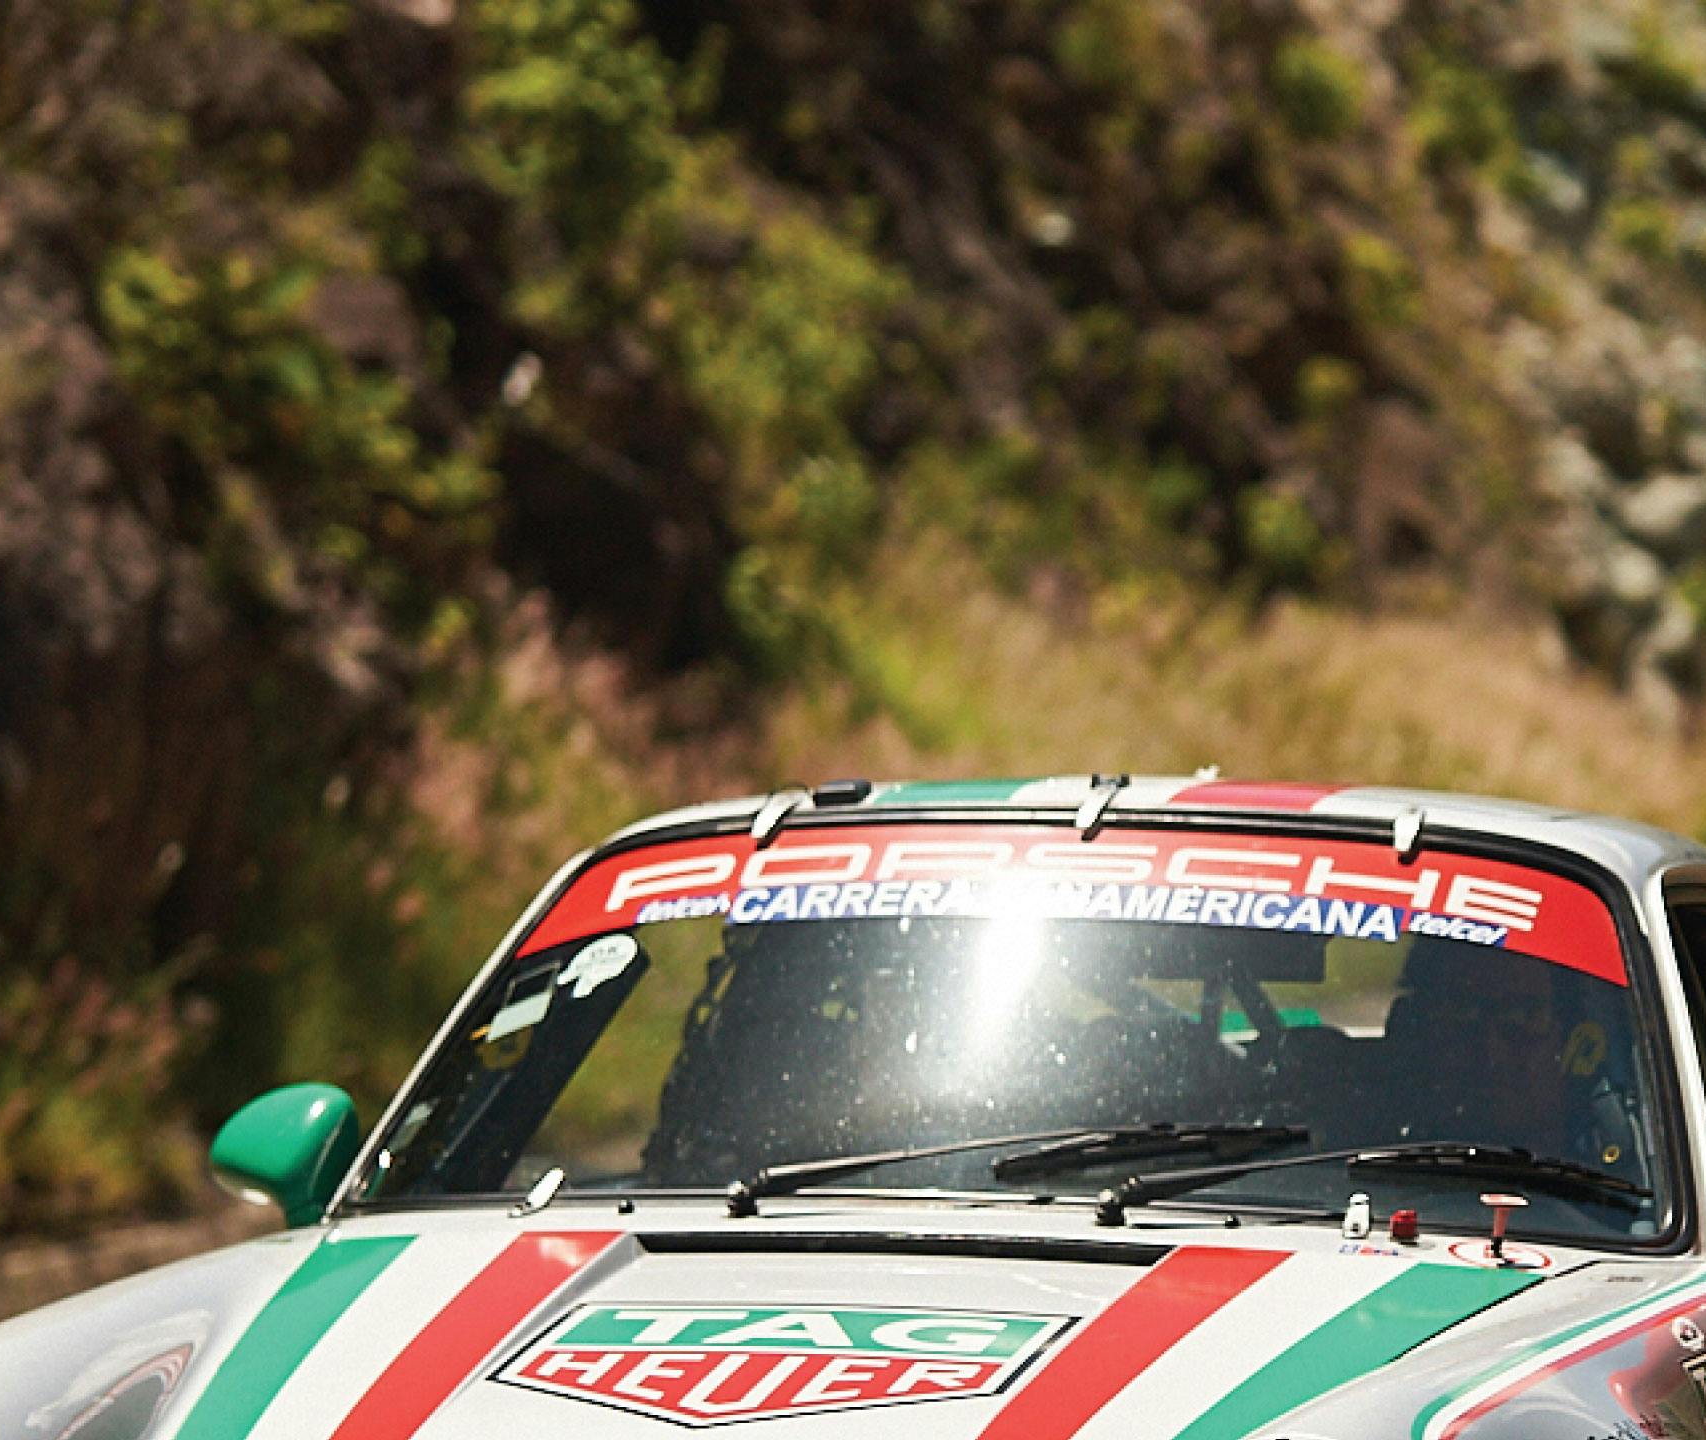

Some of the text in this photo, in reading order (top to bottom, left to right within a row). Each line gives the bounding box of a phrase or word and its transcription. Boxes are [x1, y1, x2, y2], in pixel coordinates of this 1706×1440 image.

[605, 841, 1542, 933] PORSCHE
[731, 880, 981, 924] CARRERA
[1409, 912, 1508, 945] telcel
[611, 1311, 1007, 1352] TAG
[536, 1353, 983, 1414] HEUER
